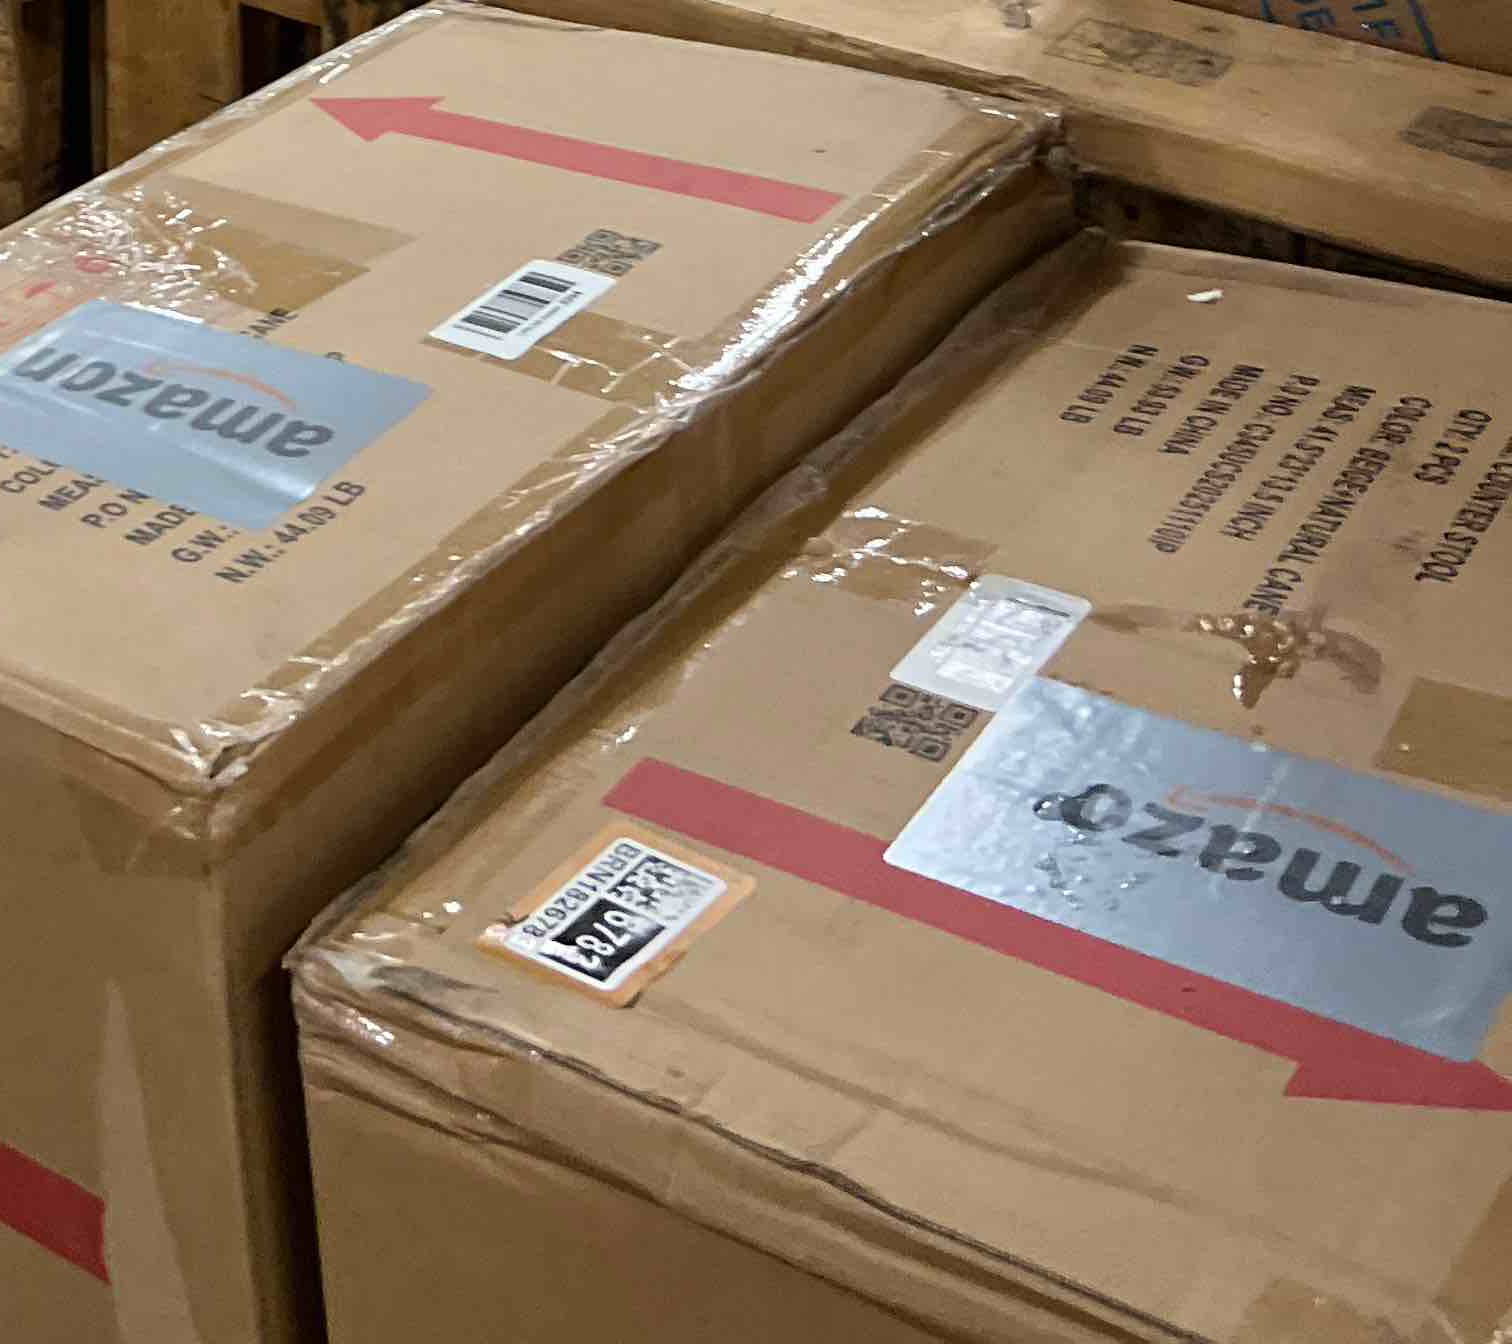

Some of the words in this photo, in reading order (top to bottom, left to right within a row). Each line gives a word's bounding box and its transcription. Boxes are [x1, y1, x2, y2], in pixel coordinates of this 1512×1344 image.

[1209, 364, 1265, 401] MADE
[12, 346, 334, 459] amazon
[1059, 405, 1100, 424] LB
[1195, 400, 1233, 415] IN
[1113, 416, 1153, 436] LB
[1158, 415, 1218, 455] CHINA
[1413, 453, 1461, 486] PCS
[324, 480, 366, 506] LB
[1218, 502, 1276, 542] INCH
[1415, 532, 1479, 583] STOOL
[1243, 568, 1301, 616] CANE
[524, 842, 644, 940] BRN182678
